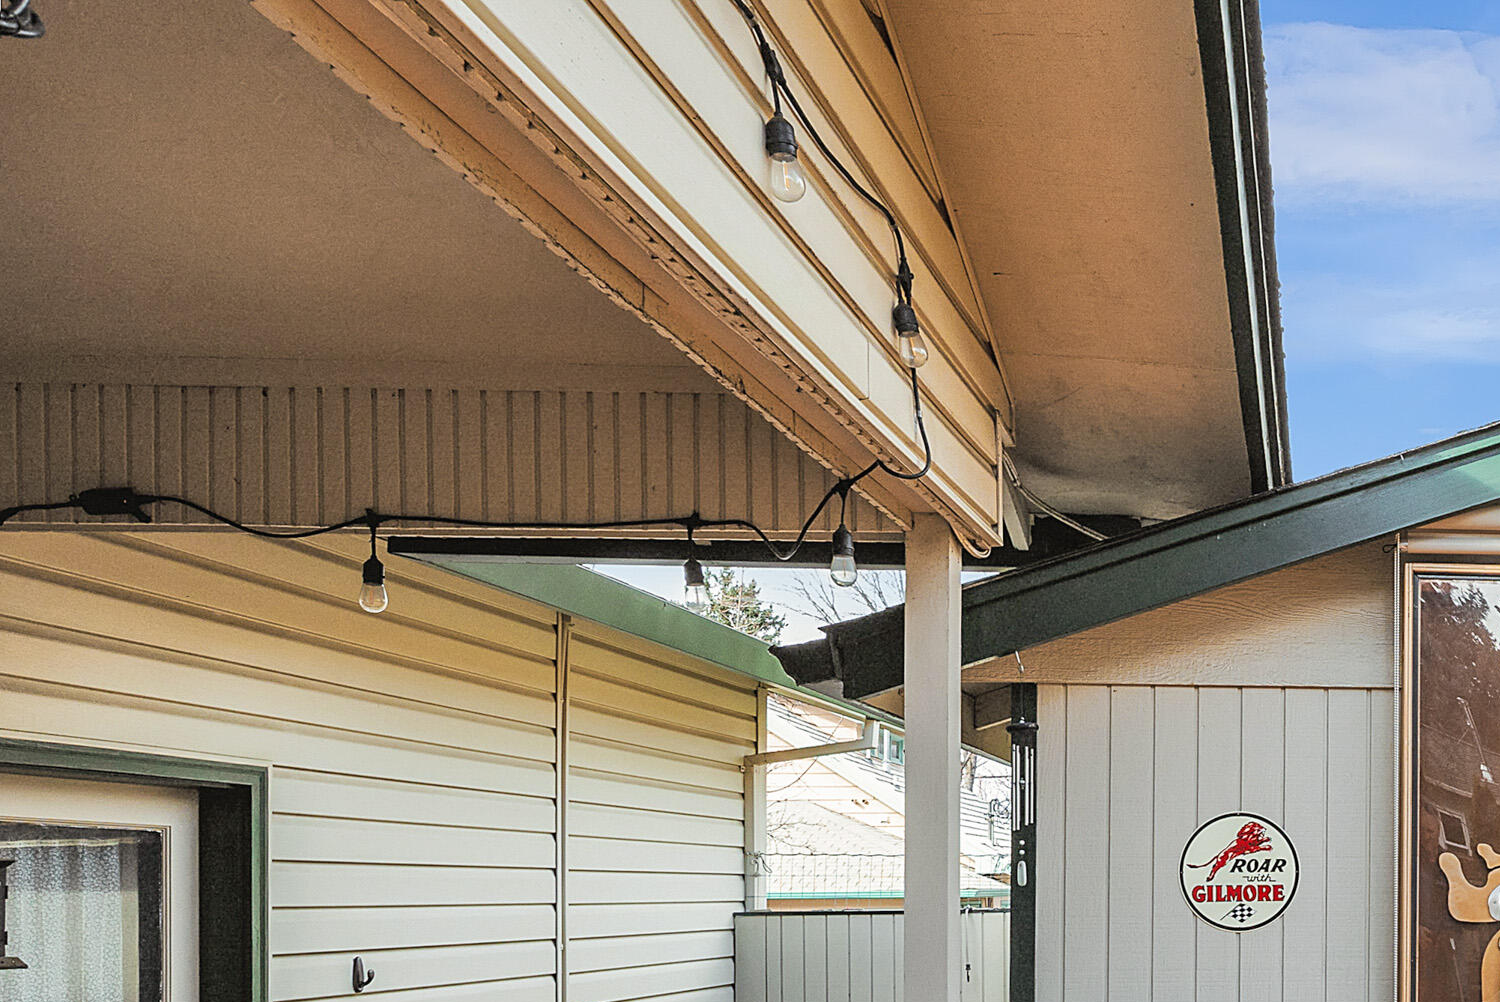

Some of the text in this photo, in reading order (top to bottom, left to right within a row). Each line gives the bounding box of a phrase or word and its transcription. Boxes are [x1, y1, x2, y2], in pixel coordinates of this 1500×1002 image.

[1229, 858, 1287, 873] ROAR
[1242, 873, 1277, 882] with
[1191, 884, 1286, 903] GILMORE
